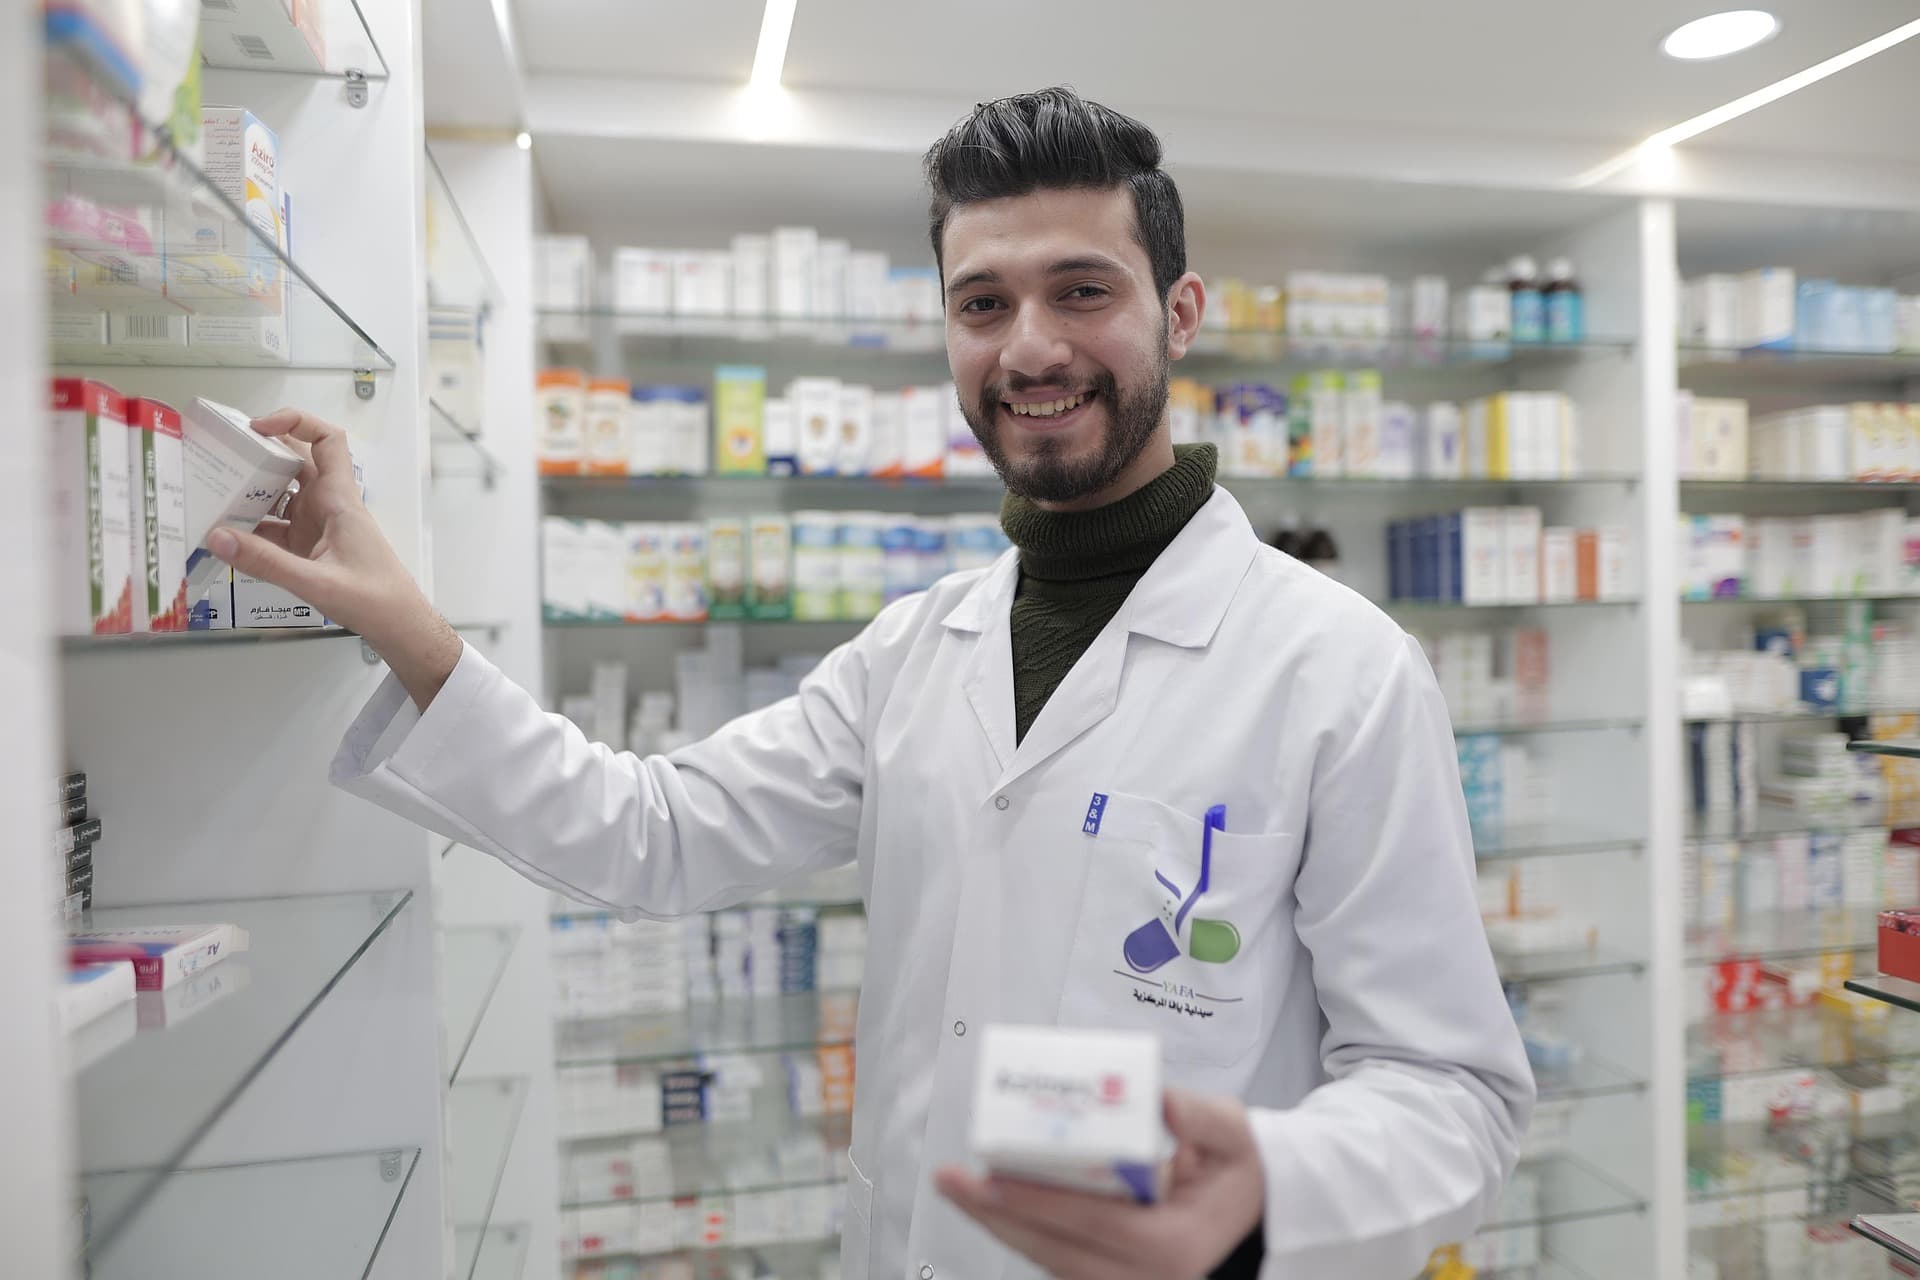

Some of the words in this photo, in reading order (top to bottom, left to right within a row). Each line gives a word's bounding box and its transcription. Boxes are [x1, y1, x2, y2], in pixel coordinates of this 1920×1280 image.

[1133, 988, 1167, 1008] المركزية
[1162, 981, 1195, 999] YAFA
[1168, 999, 1184, 1014] يافا
[1185, 1002, 1214, 1018] صيدلية
